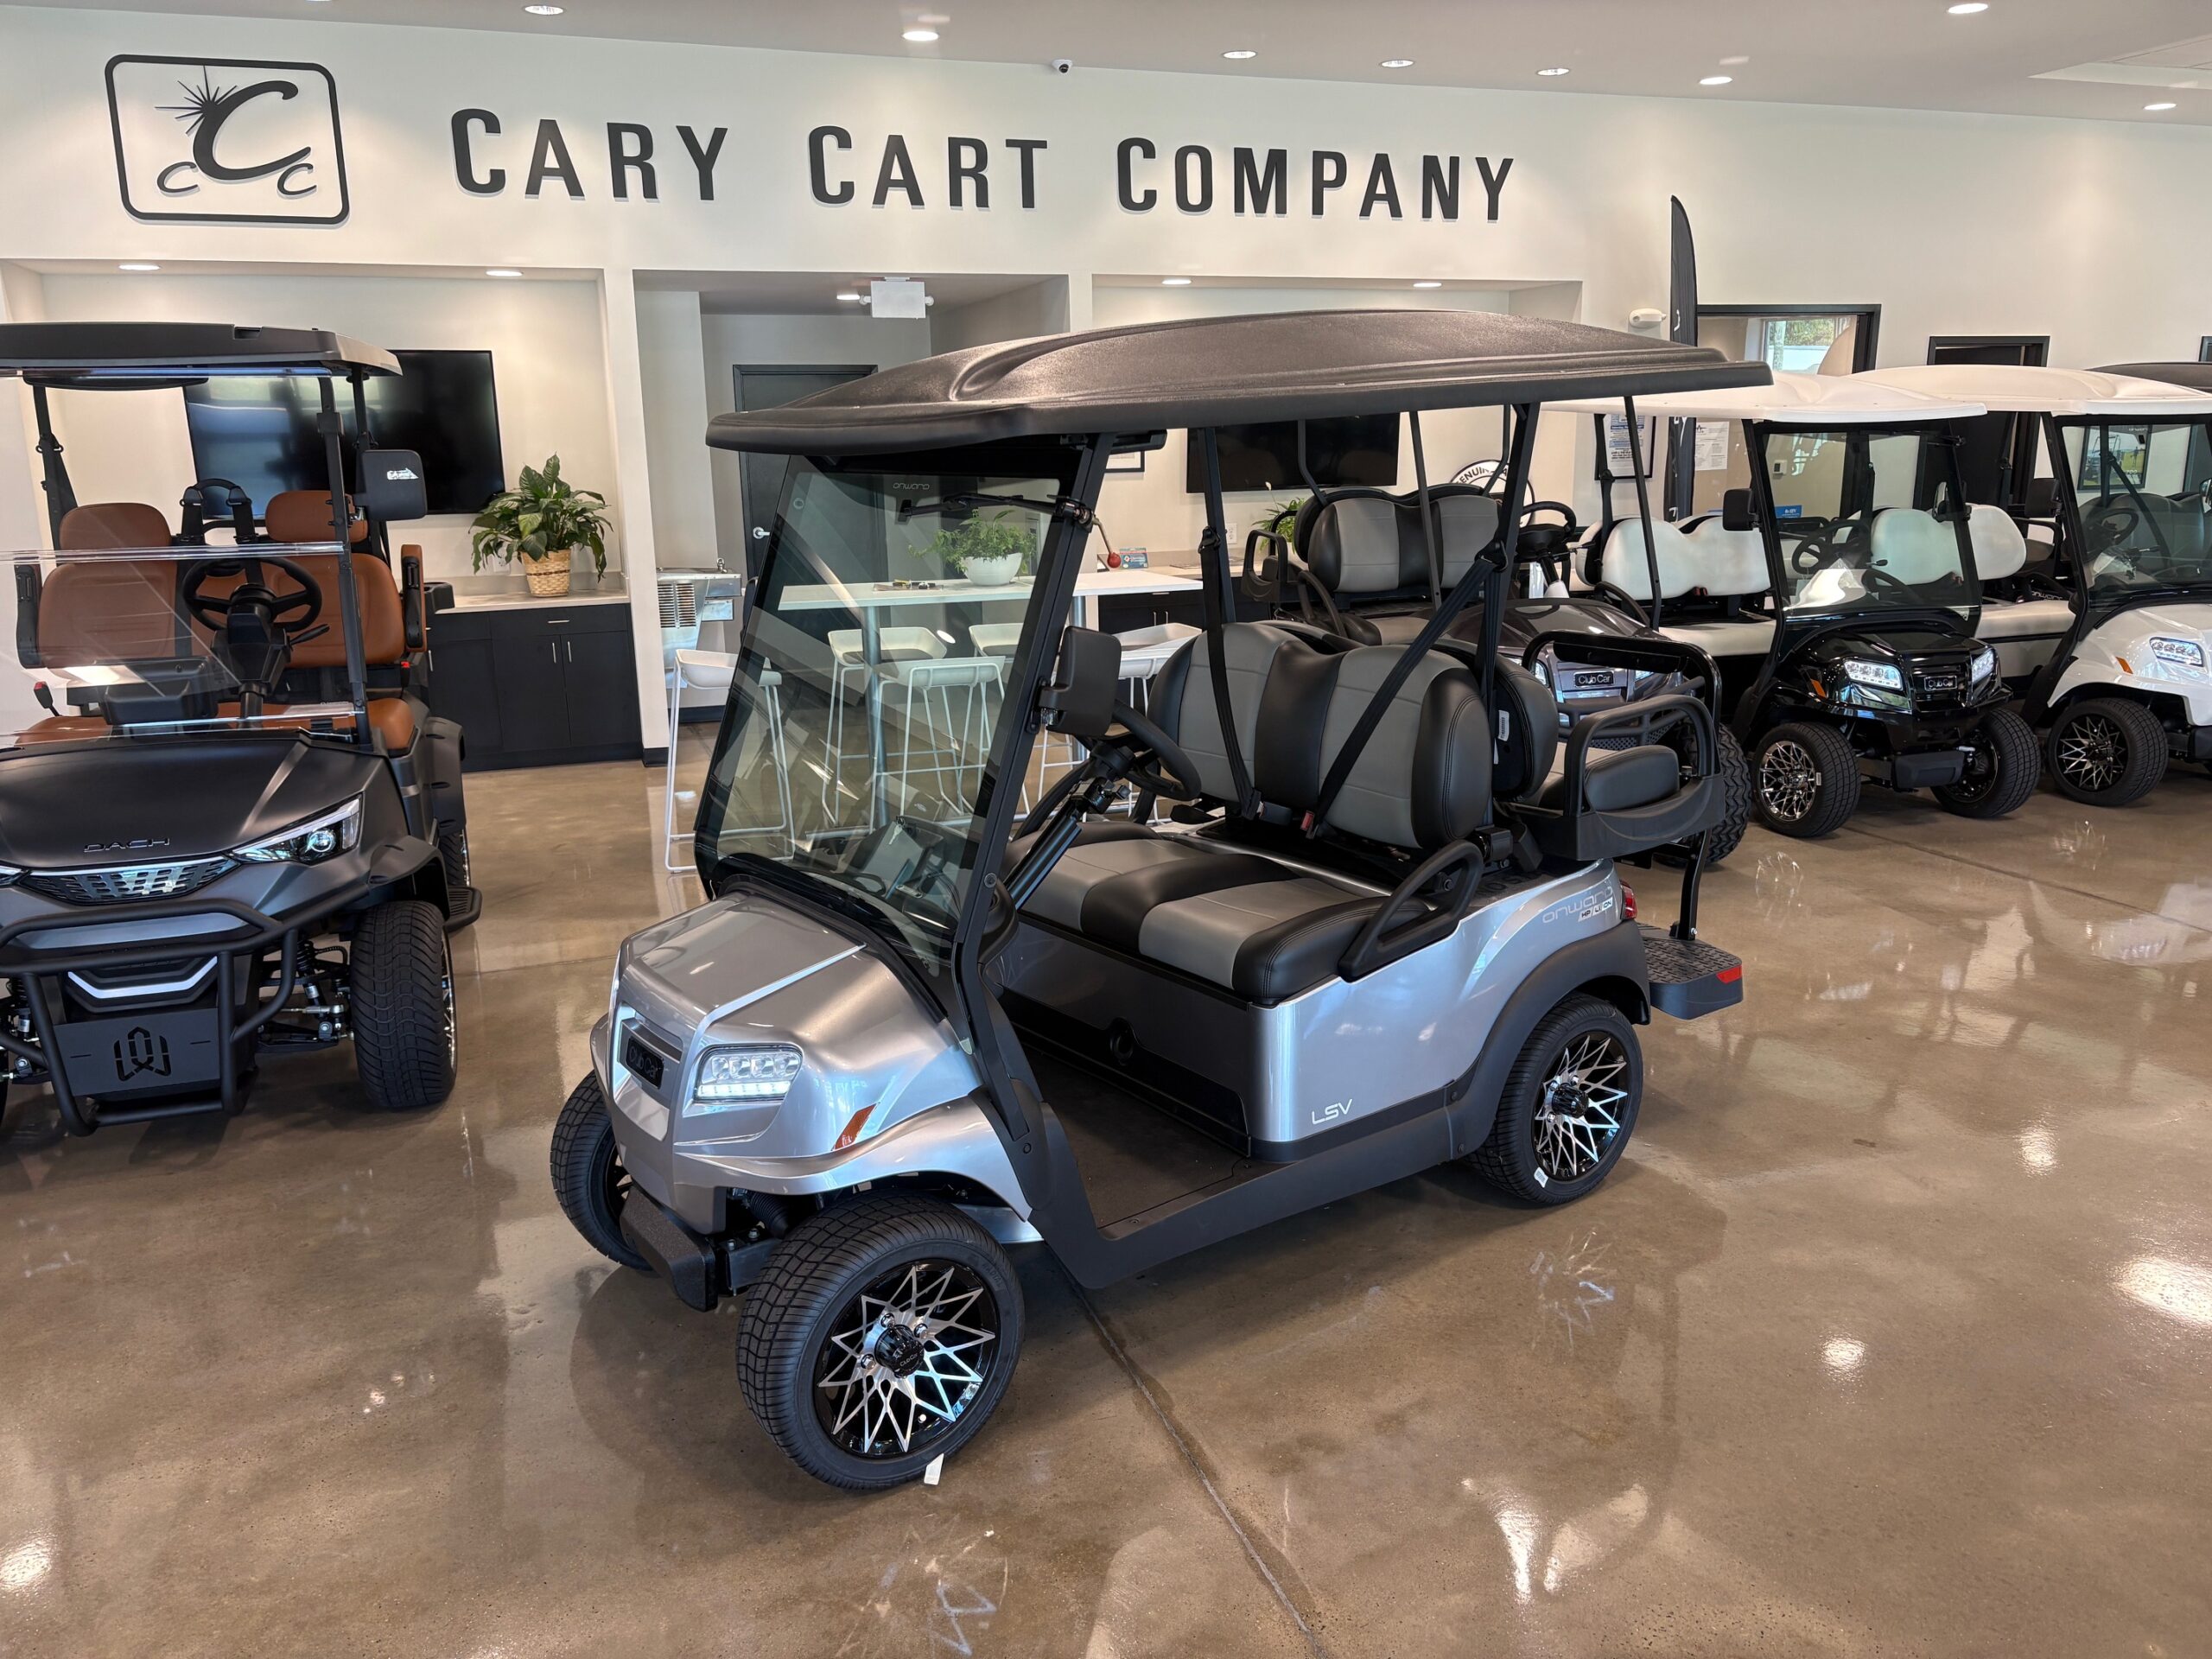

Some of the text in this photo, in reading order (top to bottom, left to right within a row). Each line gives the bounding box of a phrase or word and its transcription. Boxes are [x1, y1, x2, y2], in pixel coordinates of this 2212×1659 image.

[452, 109, 1515, 221] CARY CART COMPANY
[1578, 674, 1611, 684] Club Car
[1312, 1098, 1353, 1125] LSV
